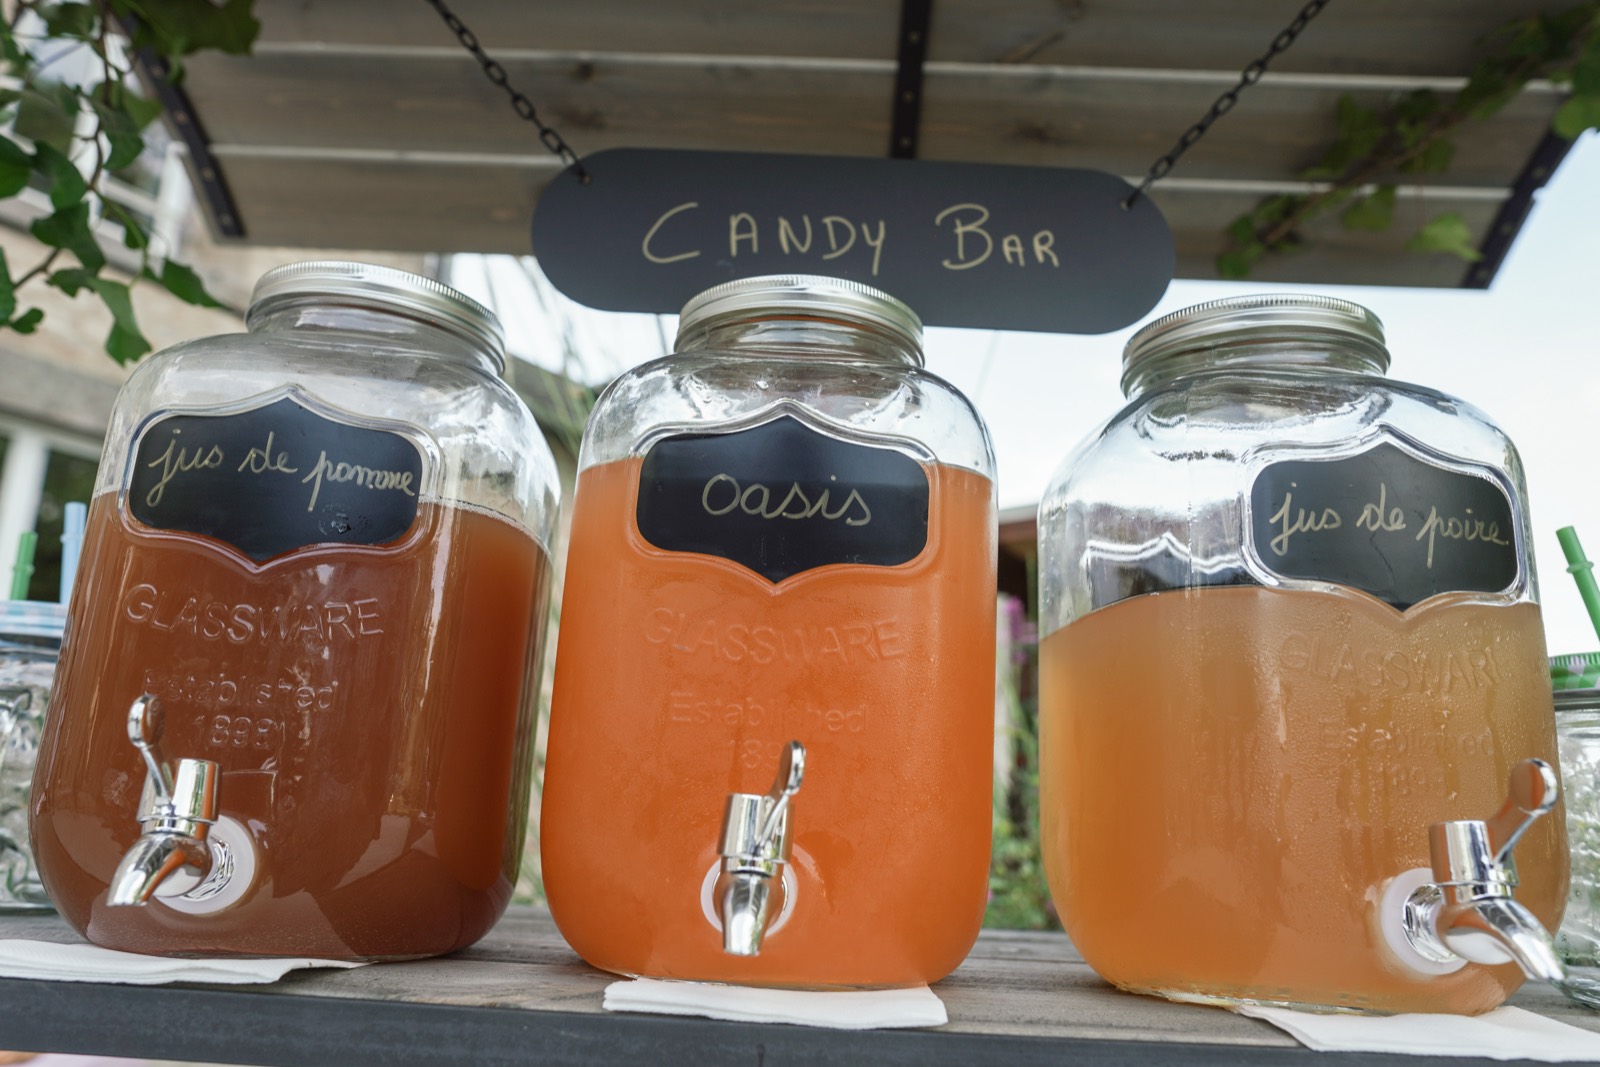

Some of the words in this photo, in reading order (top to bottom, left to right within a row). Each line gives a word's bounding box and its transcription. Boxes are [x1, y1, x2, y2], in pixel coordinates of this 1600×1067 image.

[146, 427, 224, 507] jus
[237, 430, 298, 475] de
[301, 450, 416, 512] pomme
[701, 473, 872, 526] Oasis
[1269, 481, 1342, 556] jus
[1356, 482, 1407, 532] de
[1415, 505, 1509, 569] poire
[122, 583, 385, 645] GLASSWARE
[644, 607, 905, 665] GLASSWARE
